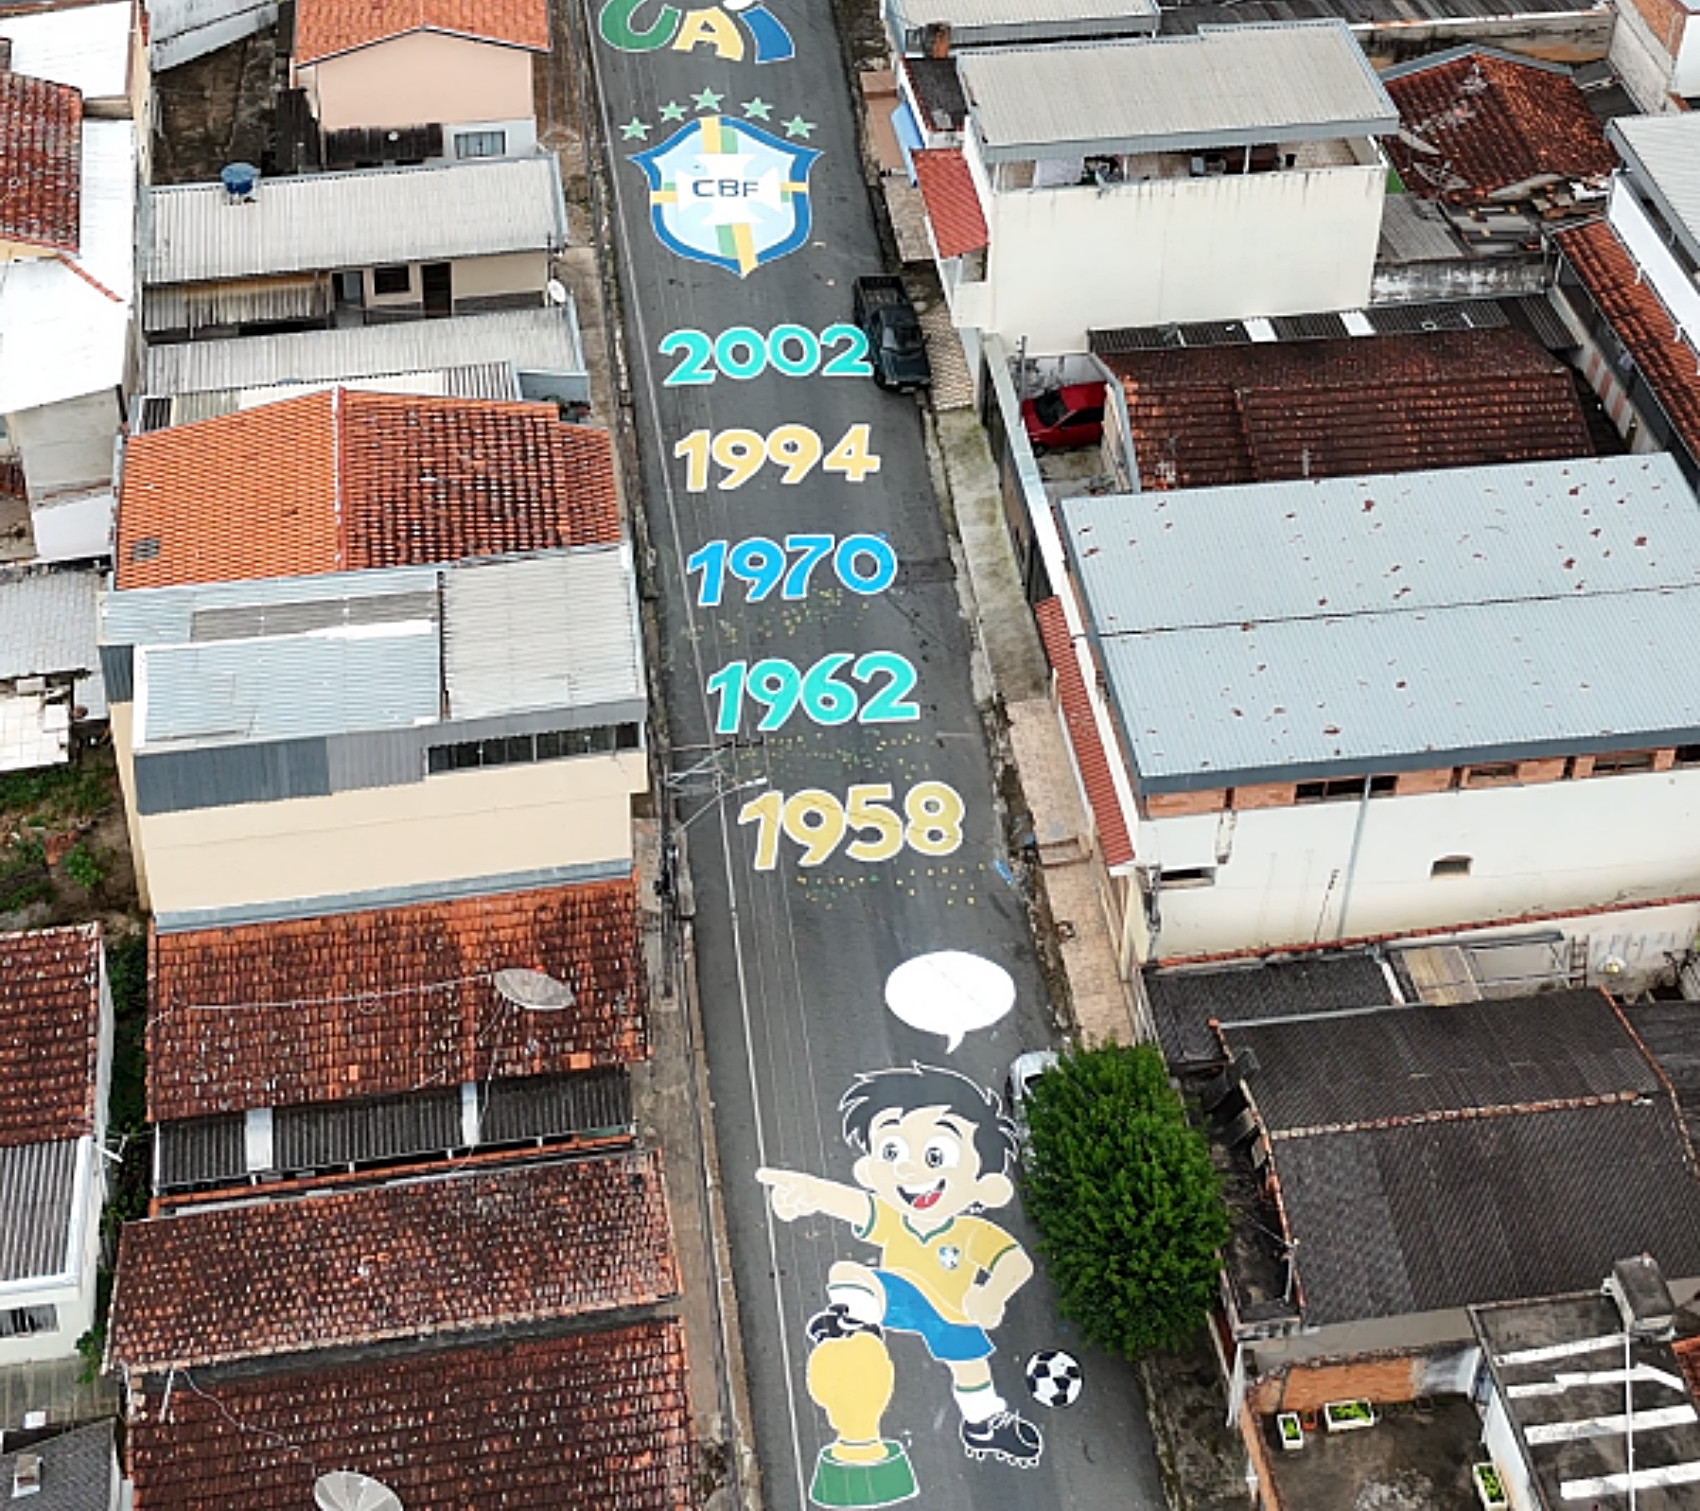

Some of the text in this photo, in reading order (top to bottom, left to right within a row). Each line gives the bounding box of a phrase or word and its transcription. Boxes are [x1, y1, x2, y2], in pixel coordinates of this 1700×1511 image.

[692, 178, 759, 199] CBF
[658, 322, 875, 387] 2002
[673, 423, 882, 492] 1994
[686, 531, 898, 607] 1970
[706, 649, 920, 734] 1962
[737, 780, 965, 871] 1958
